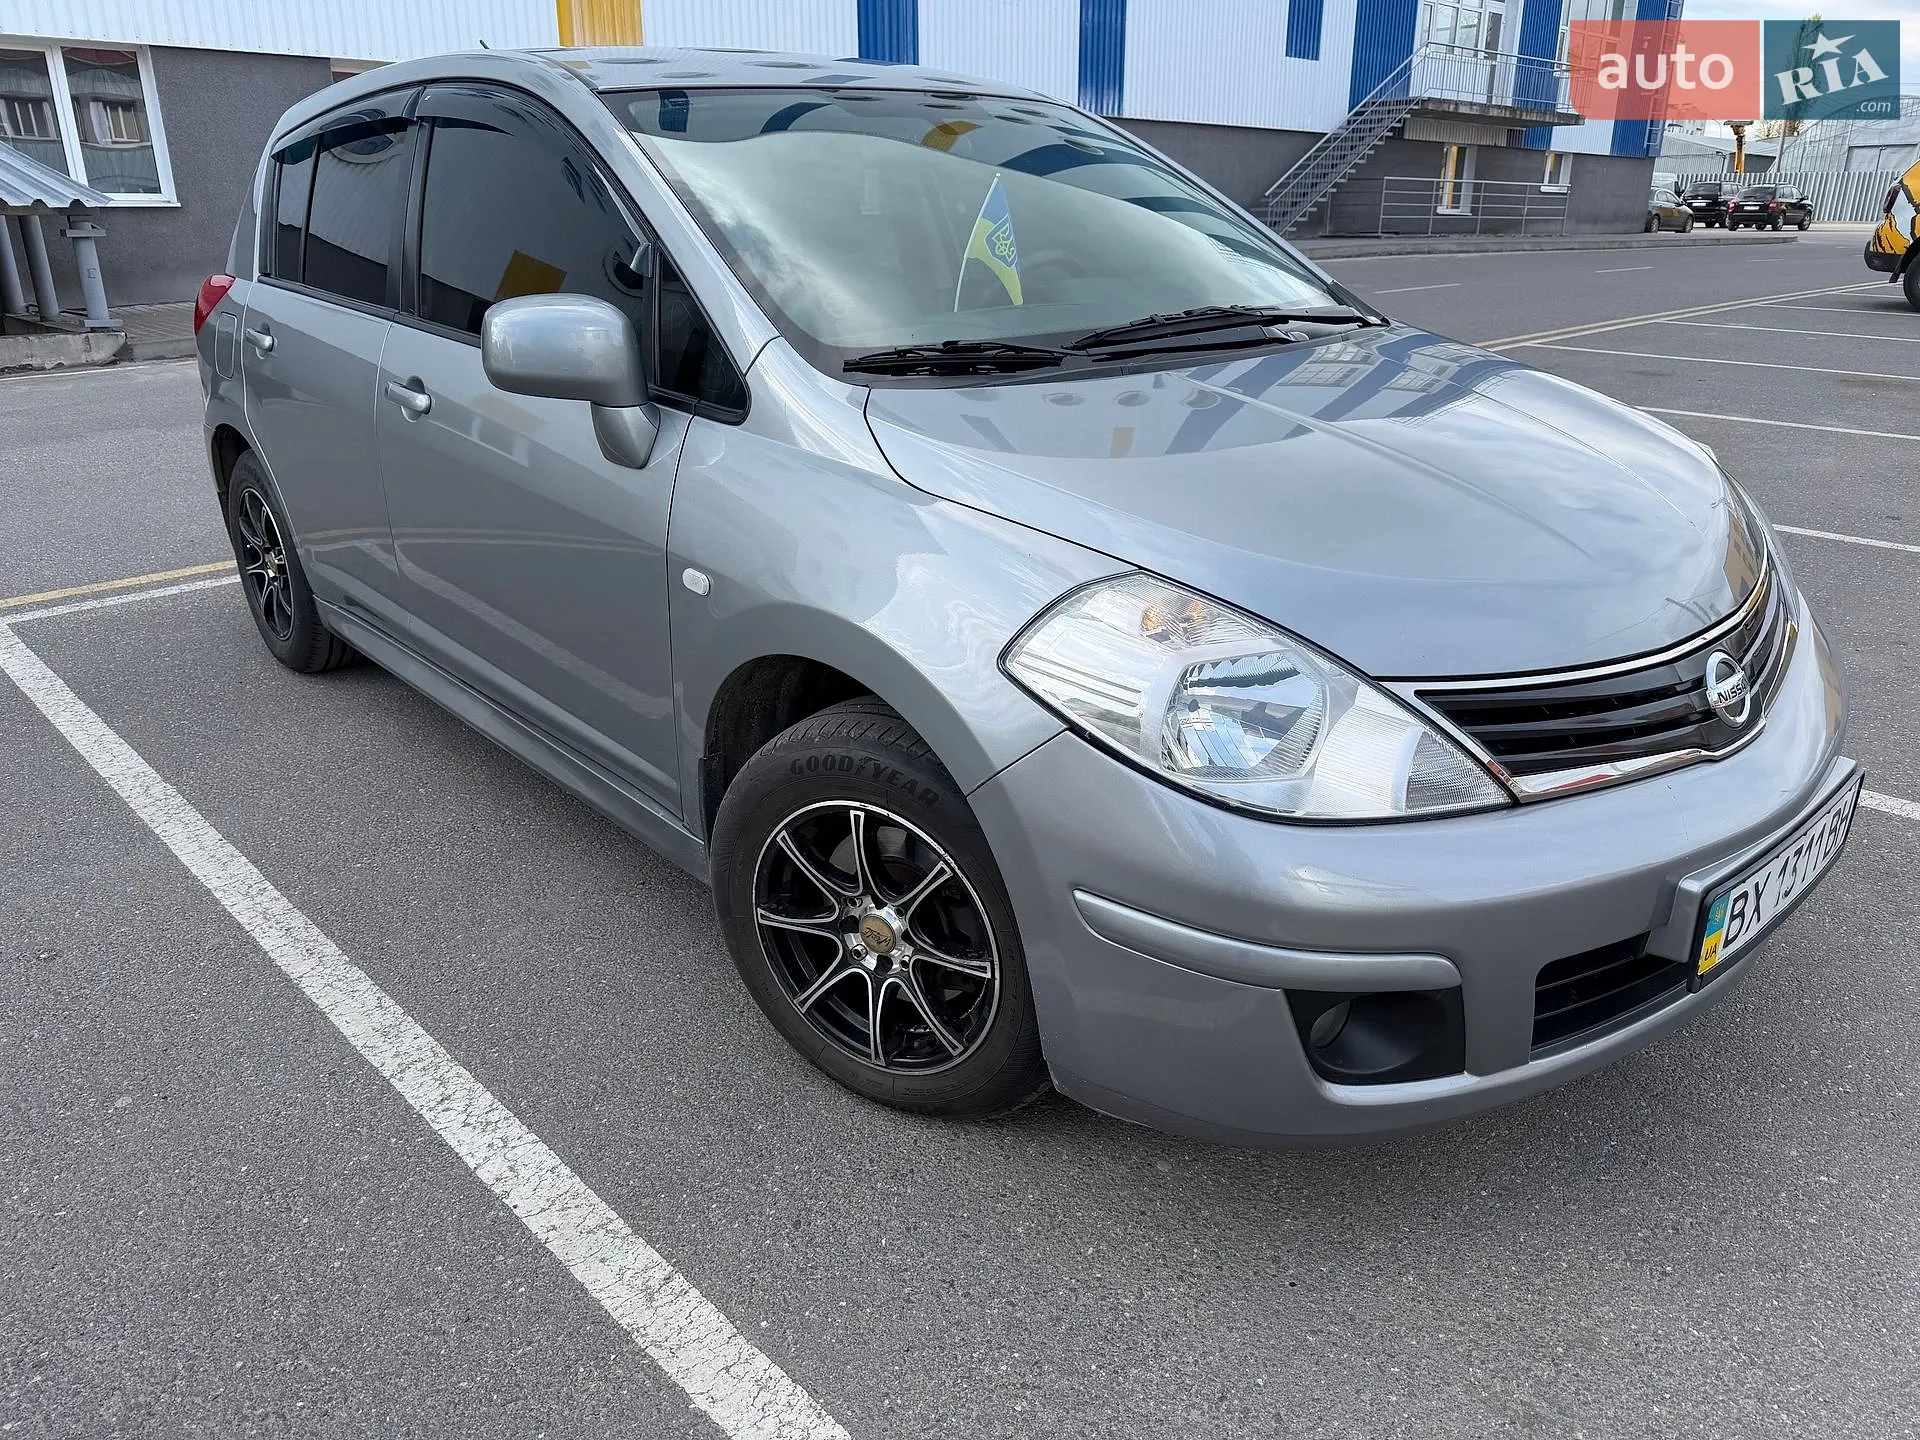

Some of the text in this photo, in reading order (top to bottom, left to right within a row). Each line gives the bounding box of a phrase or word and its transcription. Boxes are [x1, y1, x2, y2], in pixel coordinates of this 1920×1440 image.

[1723, 800, 1850, 948] BX 1311 BH
[1705, 943, 1717, 961] UA
